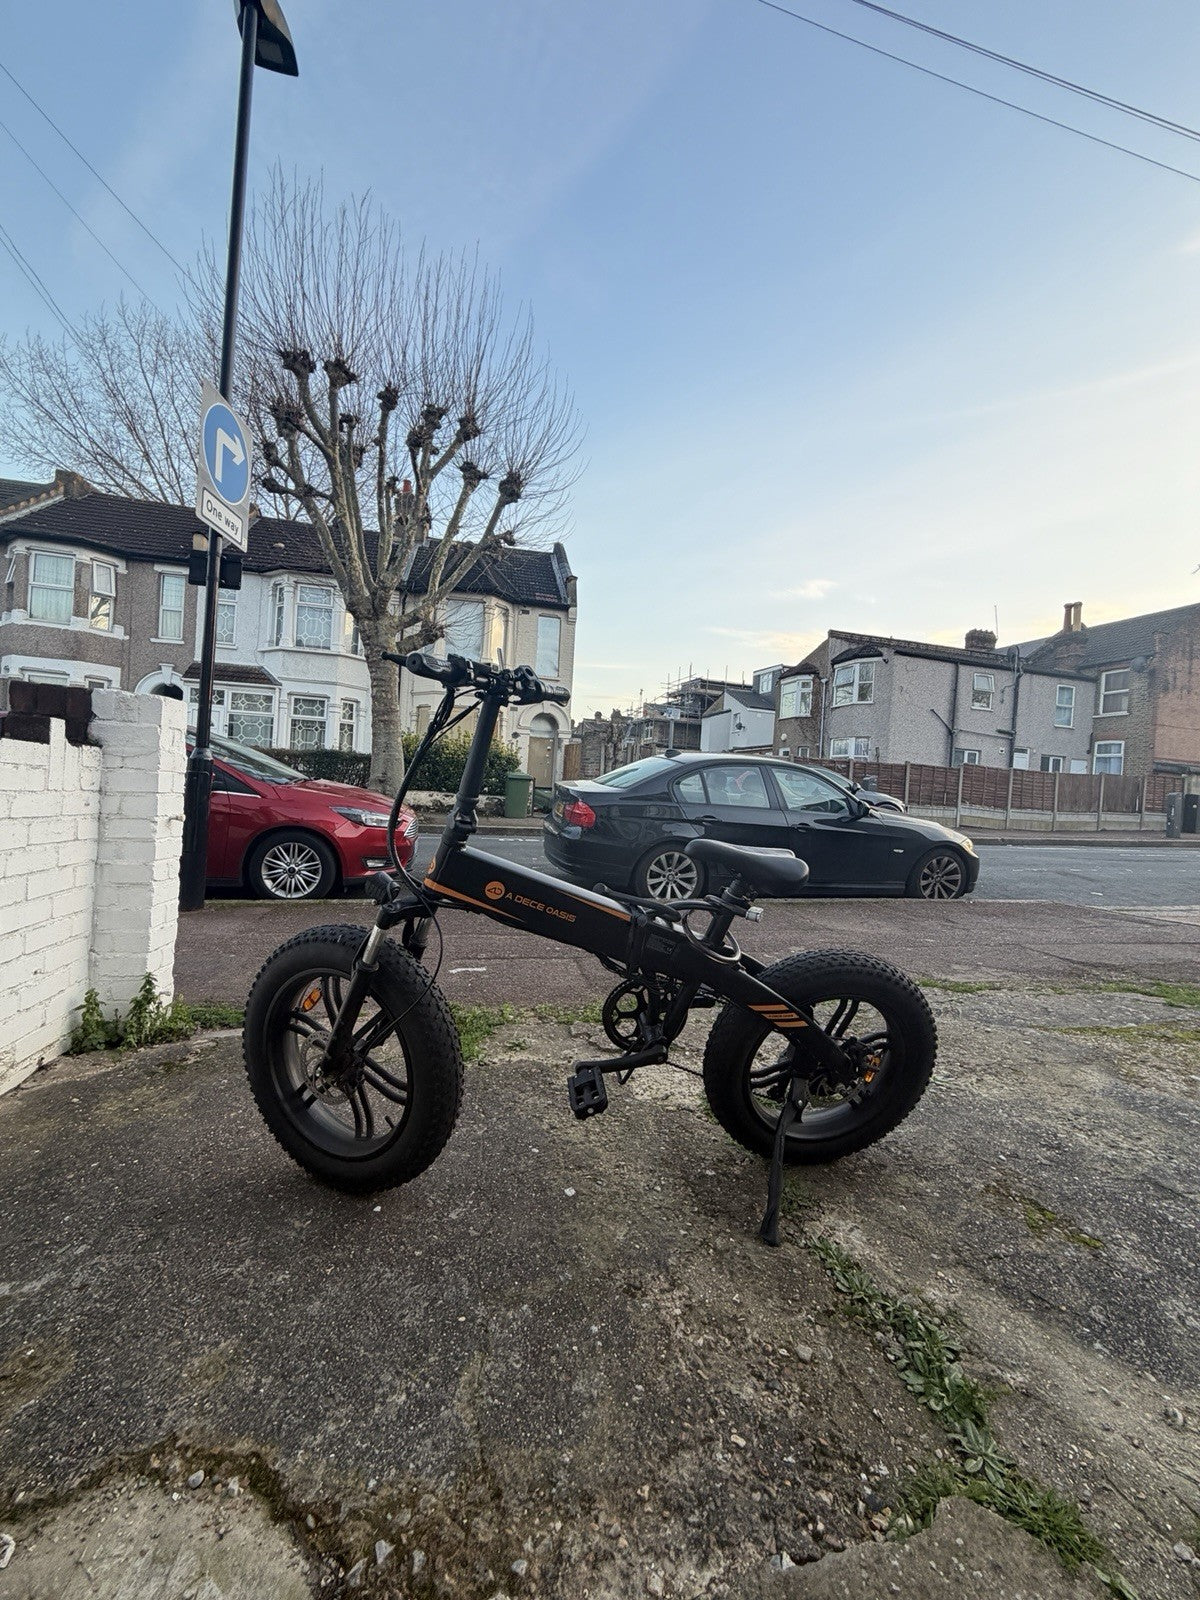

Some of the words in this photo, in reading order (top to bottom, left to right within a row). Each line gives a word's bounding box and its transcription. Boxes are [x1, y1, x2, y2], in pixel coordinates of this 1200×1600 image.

[206, 499, 223, 521] One
[224, 515, 239, 535] way
[504, 892, 513, 900] A
[514, 895, 546, 912] DECE
[545, 906, 577, 923] OASIS
